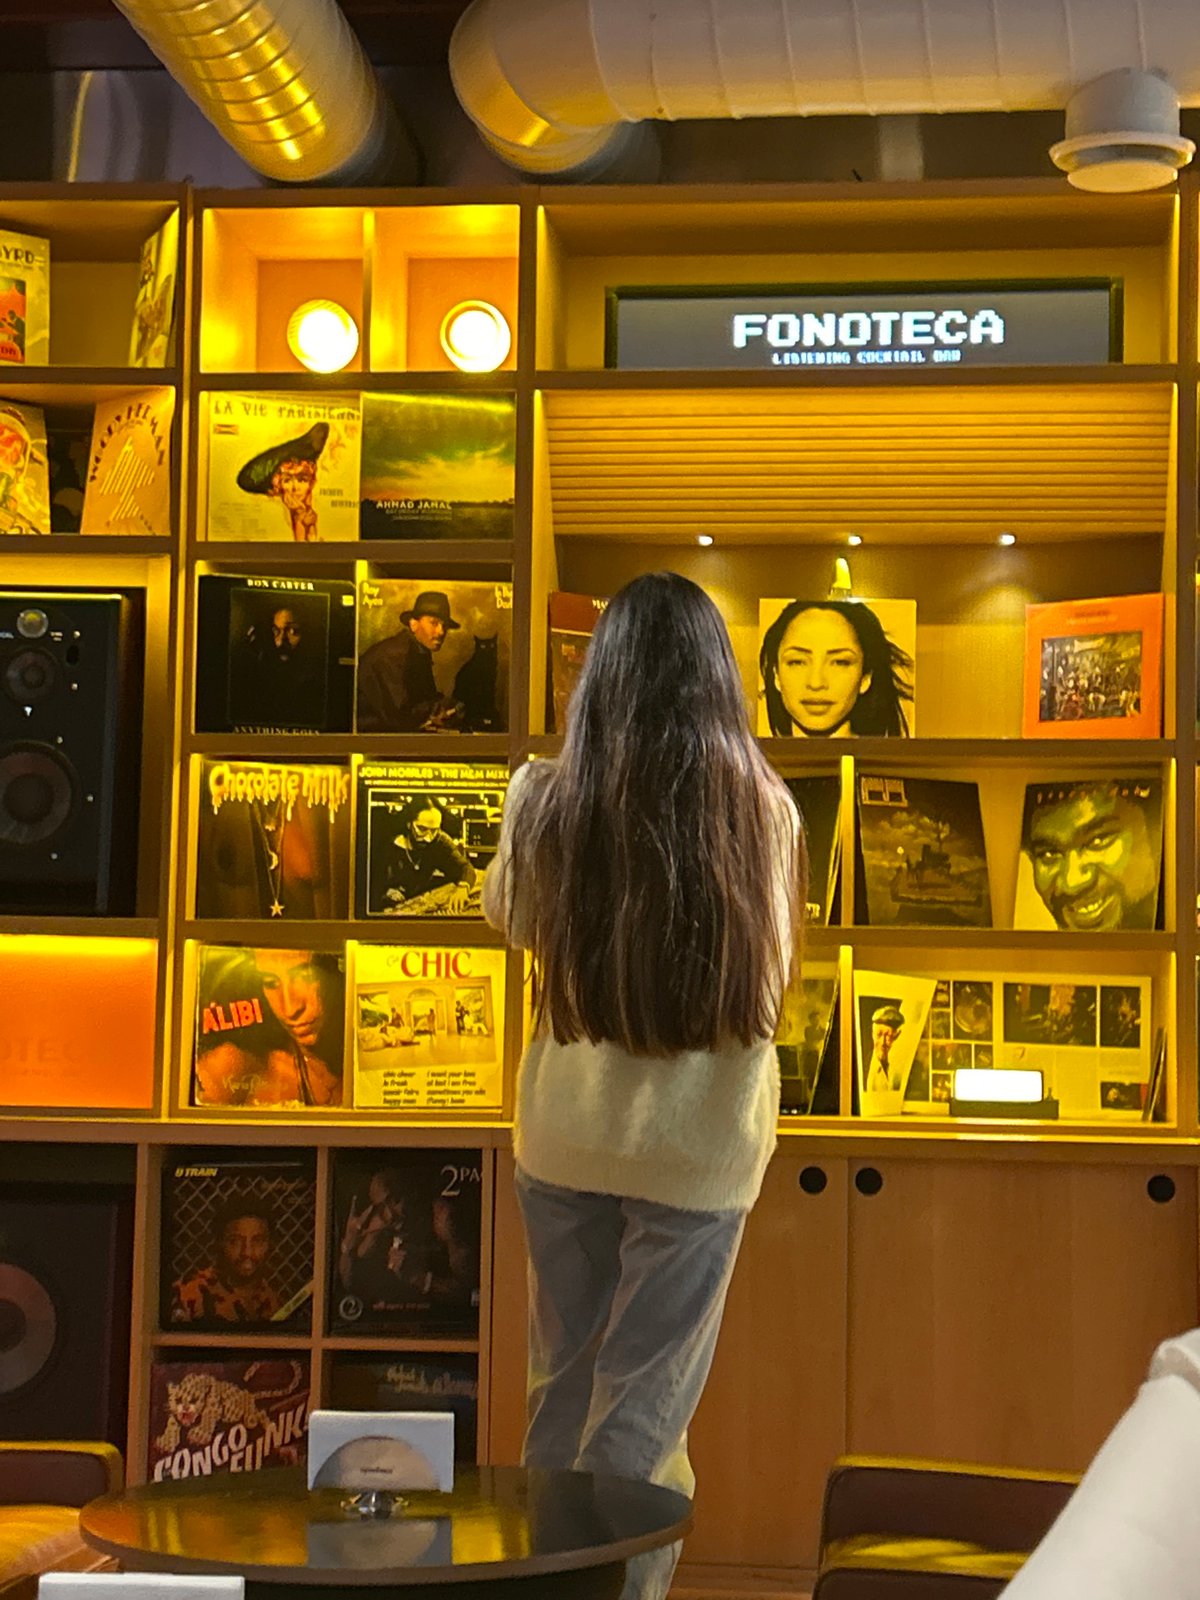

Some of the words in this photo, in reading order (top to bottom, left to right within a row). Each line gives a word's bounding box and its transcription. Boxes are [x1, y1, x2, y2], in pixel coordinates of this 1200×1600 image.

[0, 244, 35, 266] YRD
[733, 309, 1006, 348] FONOTECA
[771, 350, 851, 365] LISTENING
[857, 349, 926, 364] COCKTAIL
[213, 399, 233, 416] LA
[376, 500, 415, 510] AHMAD
[418, 500, 453, 511] JAMAL
[272, 580, 315, 591] CARTER
[440, 768, 459, 779] THE
[209, 763, 300, 813] Chocolate
[302, 766, 351, 814] Milk
[401, 950, 473, 979] CHIC
[185, 1167, 219, 1177] TRAIN
[440, 1165, 483, 1197] 2PA
